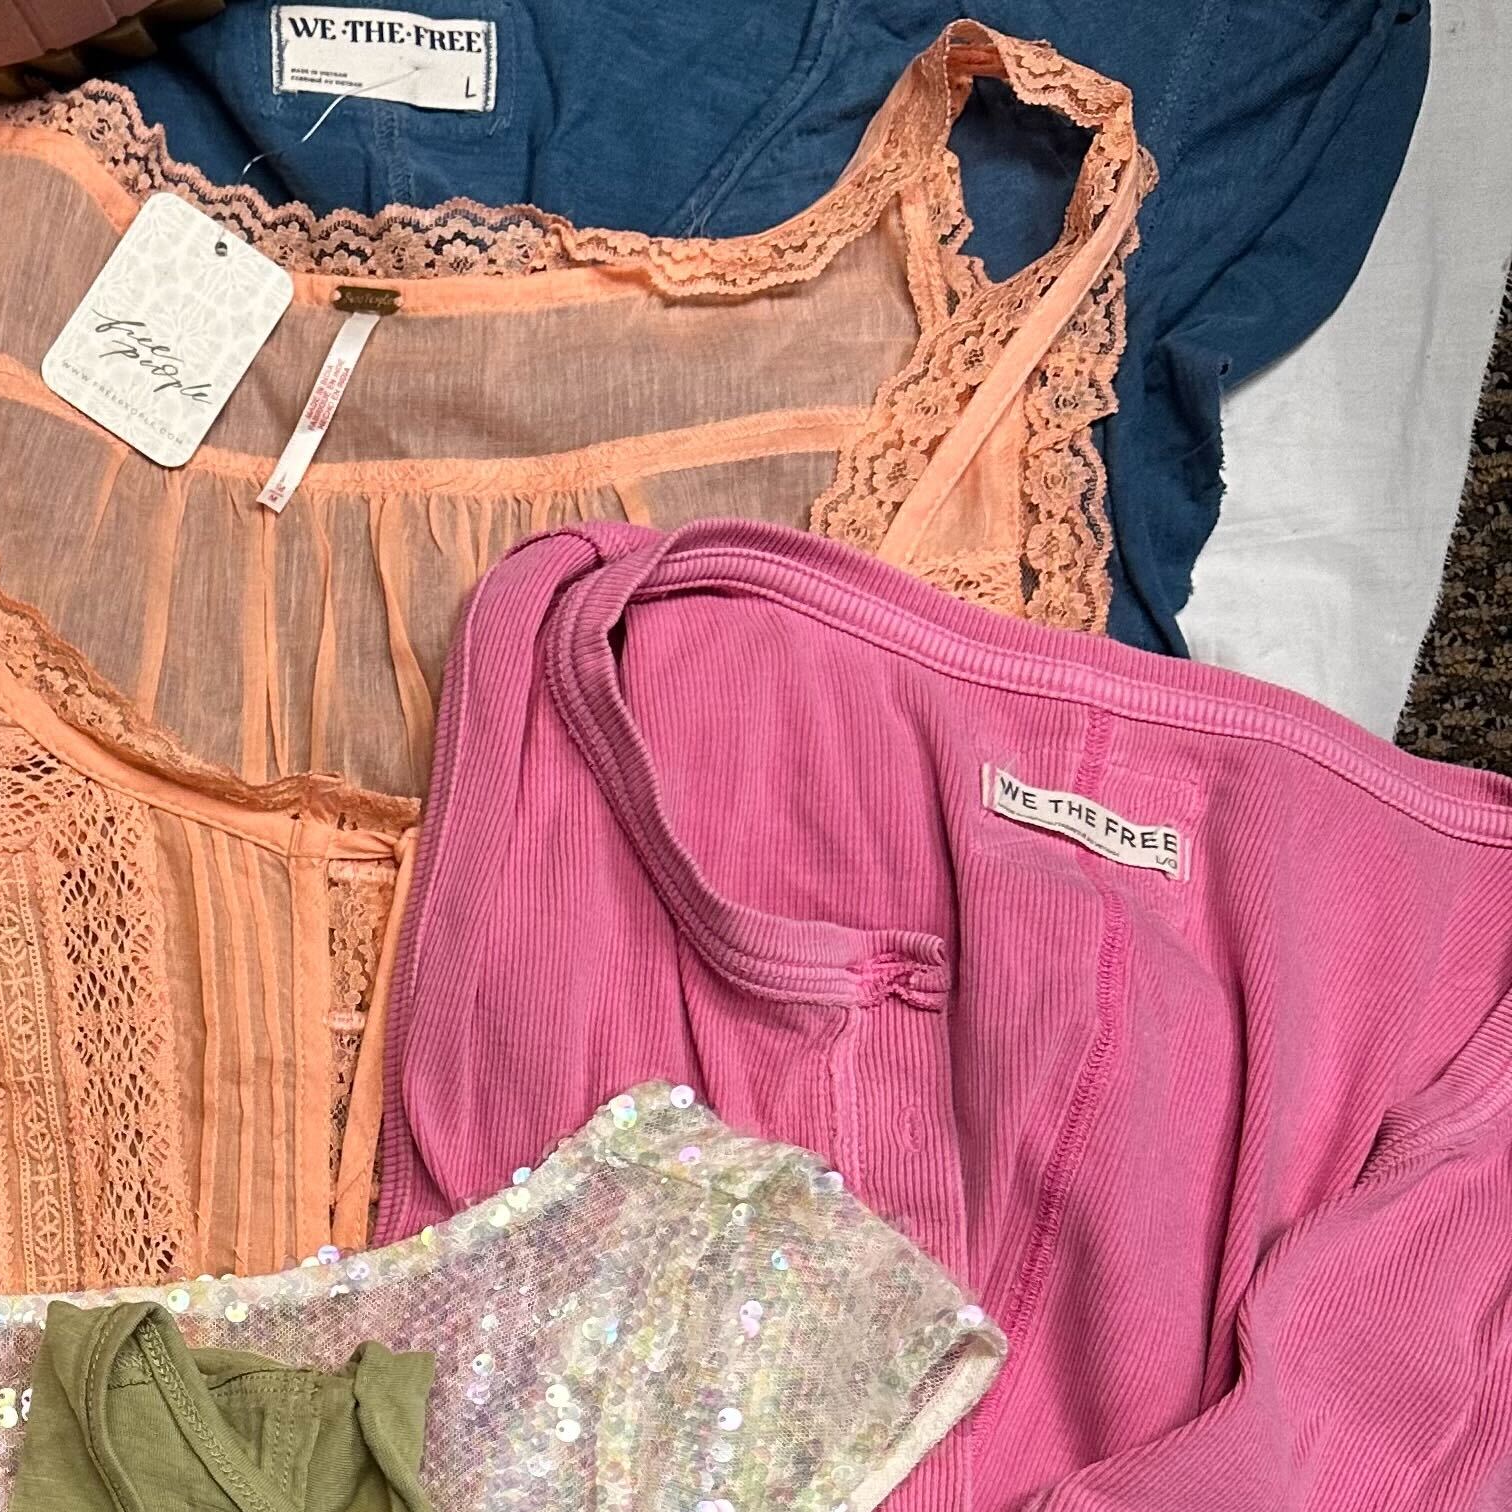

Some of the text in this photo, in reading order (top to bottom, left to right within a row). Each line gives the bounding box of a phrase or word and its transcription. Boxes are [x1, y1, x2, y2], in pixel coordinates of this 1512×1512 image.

[465, 76, 477, 98] L
[999, 776, 1037, 811] WE
[1049, 799, 1096, 828] THE
[1104, 816, 1178, 854] FREE
